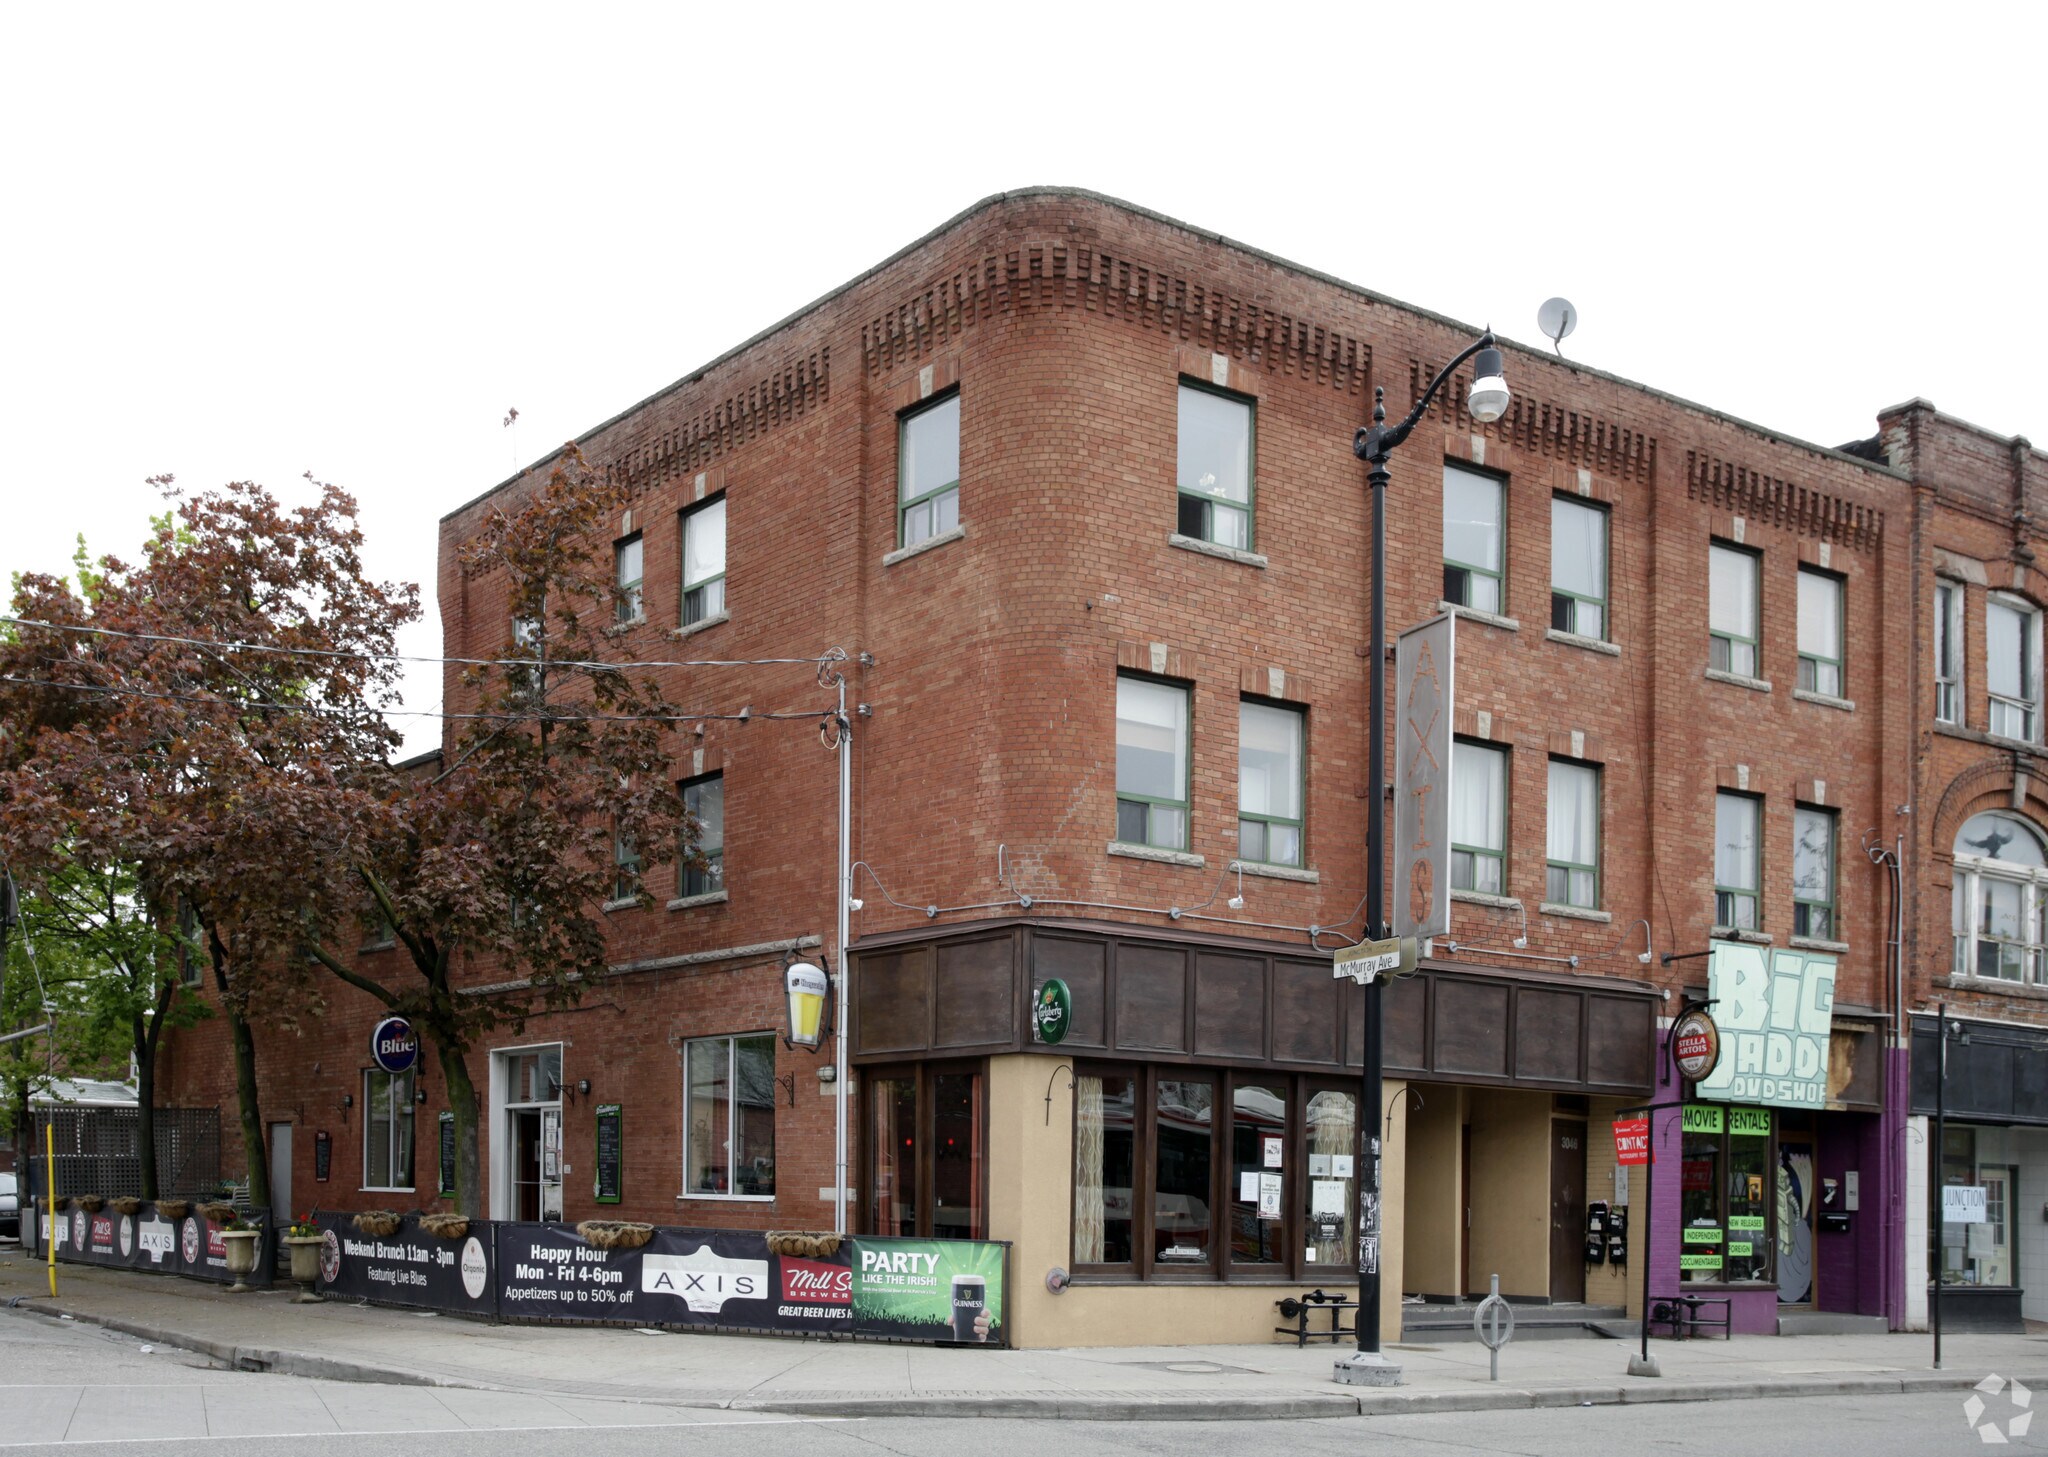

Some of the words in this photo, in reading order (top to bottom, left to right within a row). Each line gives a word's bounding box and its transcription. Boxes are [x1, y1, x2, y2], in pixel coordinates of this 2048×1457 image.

[1407, 639, 1441, 925] AXIS
[1340, 959, 1377, 976] McMurray
[1378, 956, 1392, 968] Ave
[381, 1039, 414, 1054] Blue
[1678, 1037, 1706, 1047] STELLA
[1679, 1045, 1707, 1055] ARTOIS
[1683, 1109, 1717, 1128] MOVIE
[1729, 1111, 1769, 1131] RENTALS
[1617, 1136, 1648, 1150] CONTAC
[1945, 1189, 1985, 1207] JUNCTION
[1729, 1218, 1739, 1227] NEW
[1740, 1219, 1762, 1227] RELEASES
[45, 1226, 66, 1239] AIS
[1687, 1231, 1720, 1240] INDEPENDENT
[142, 1234, 171, 1249] AXIS
[1728, 1244, 1750, 1253] FOREIGN
[344, 1238, 375, 1257] Weekend
[377, 1242, 405, 1260] Brunch
[407, 1244, 428, 1263] 11am
[436, 1247, 454, 1268] 3pm
[531, 1244, 572, 1264] Happy
[575, 1246, 608, 1262] Hour
[463, 1263, 485, 1275] Organic
[861, 1250, 940, 1275] PARTY
[1680, 1257, 1720, 1266] DOCUMENTARIES
[367, 1266, 396, 1286] Featuring
[397, 1269, 409, 1284] Live
[411, 1270, 427, 1286] Blues
[515, 1264, 544, 1279] Mon
[557, 1265, 575, 1281] Fri
[579, 1266, 623, 1285] 4-6pm
[786, 1269, 833, 1290] Mill
[862, 1273, 883, 1284] LIKE
[885, 1275, 904, 1285] THE
[907, 1276, 937, 1287] IRISH!
[654, 1271, 754, 1295] AXIS
[505, 1285, 557, 1301] Appetizers
[560, 1291, 574, 1303] up
[577, 1289, 588, 1301] to
[591, 1289, 617, 1303] 50%
[620, 1290, 634, 1303] off
[953, 1298, 983, 1308] GUINNESS
[778, 1305, 801, 1317] GREAT
[803, 1307, 824, 1318] BEER
[825, 1308, 846, 1319] LIVES
